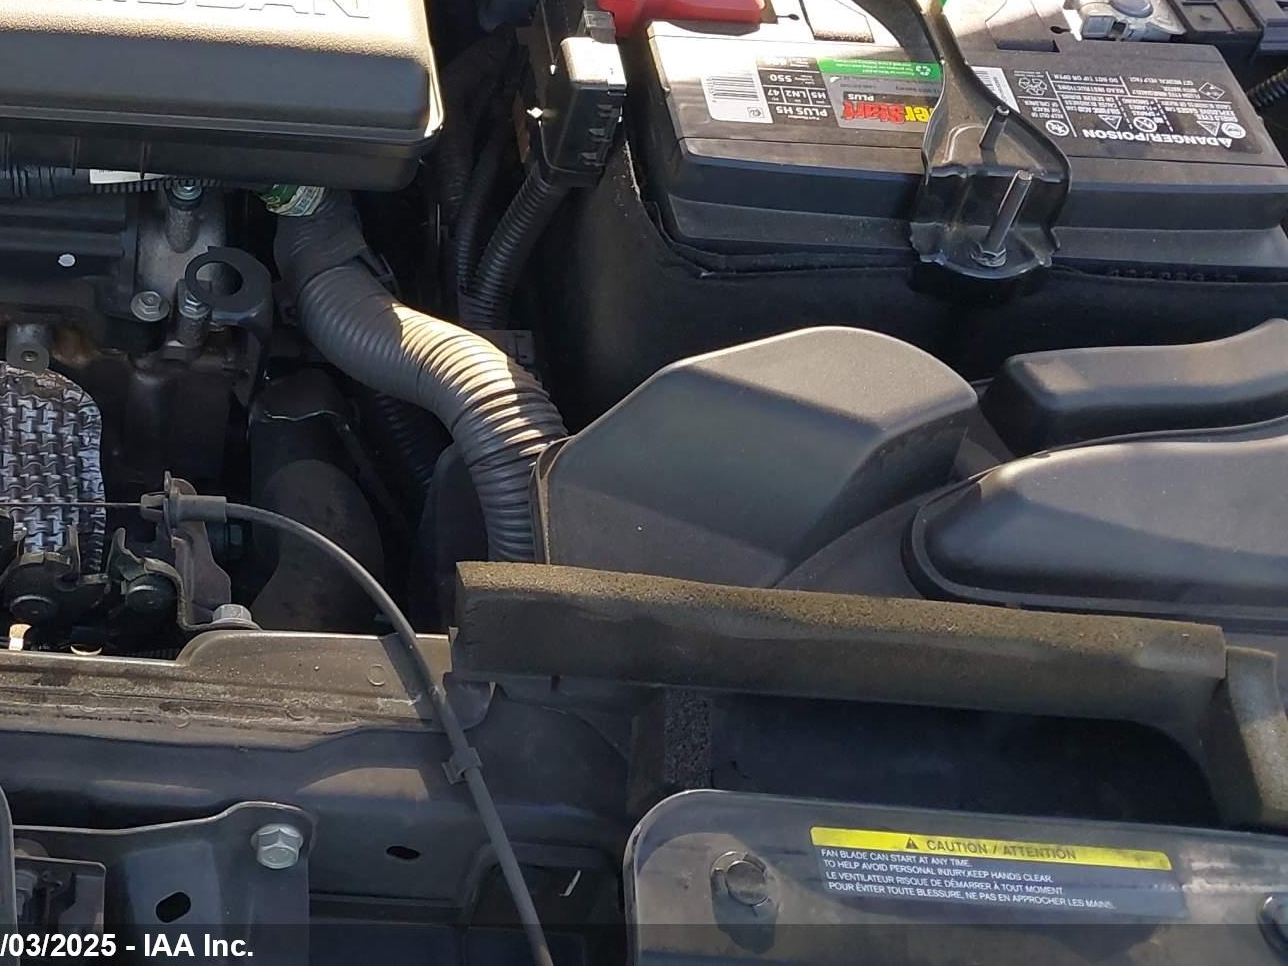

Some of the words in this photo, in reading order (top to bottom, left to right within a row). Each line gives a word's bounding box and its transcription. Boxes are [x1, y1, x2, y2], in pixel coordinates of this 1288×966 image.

[785, 90, 806, 98] LN2
[848, 93, 874, 101] PLUS
[776, 106, 793, 114] H5
[796, 107, 828, 116] PLUS
[843, 101, 933, 124] erStart
[1083, 129, 1219, 146] DANGER/POISON
[821, 849, 839, 858] FAN
[841, 851, 868, 860] BLADE
[870, 853, 889, 862] CAN
[891, 855, 918, 864] START
[919, 856, 928, 864] AT
[927, 840, 987, 854] CAUTION
[1003, 845, 1076, 860] ATTENTION
[824, 860, 836, 868] TO
[837, 861, 859, 870] HELP
[862, 863, 888, 872] AVOID
[890, 865, 936, 876] PERSONAL
[991, 872, 1022, 881] HANDS
[826, 872, 836, 880] LE
[839, 872, 894, 884] VENTILATEUR
[896, 877, 928, 886] RISQUE
[930, 879, 942, 887] DE
[944, 878, 992, 890] DÉMARRER
[994, 881, 1000, 890] À
[1001, 883, 1024, 892] TOUT
[829, 882, 854, 891] POUR
[856, 881, 885, 893] ÉVITER
[887, 887, 915, 896] TOUTE
[966, 892, 978, 900] NE
[998, 894, 1010, 902] EN
[1013, 895, 1066, 906] APPROCHER
[1068, 899, 1084, 907] LES
